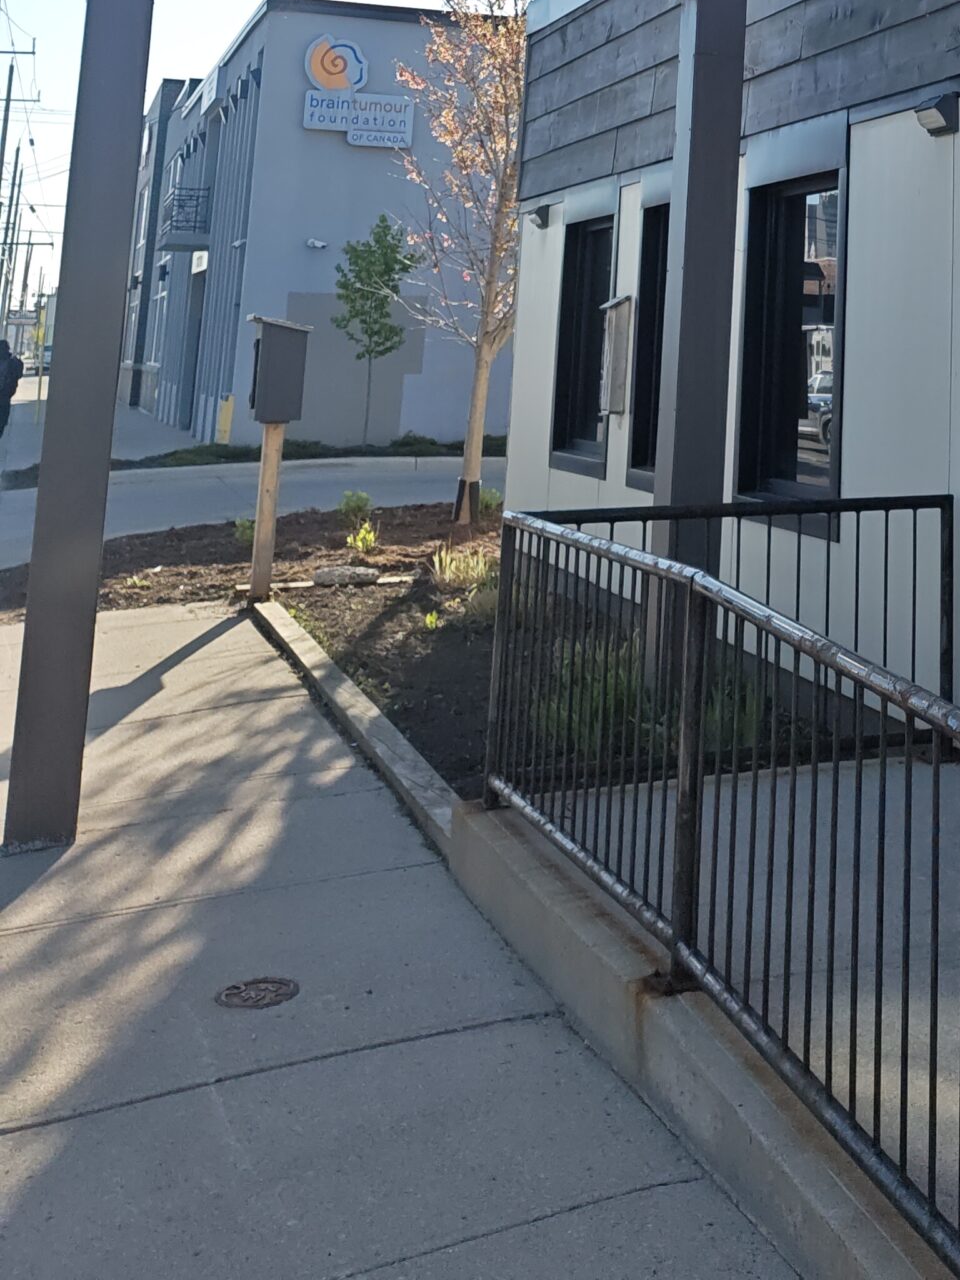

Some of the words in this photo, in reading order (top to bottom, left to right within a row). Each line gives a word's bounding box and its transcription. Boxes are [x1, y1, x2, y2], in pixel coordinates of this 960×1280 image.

[309, 111, 407, 128] foundation
[351, 133, 364, 142] OF
[366, 134, 406, 144] CANADA
